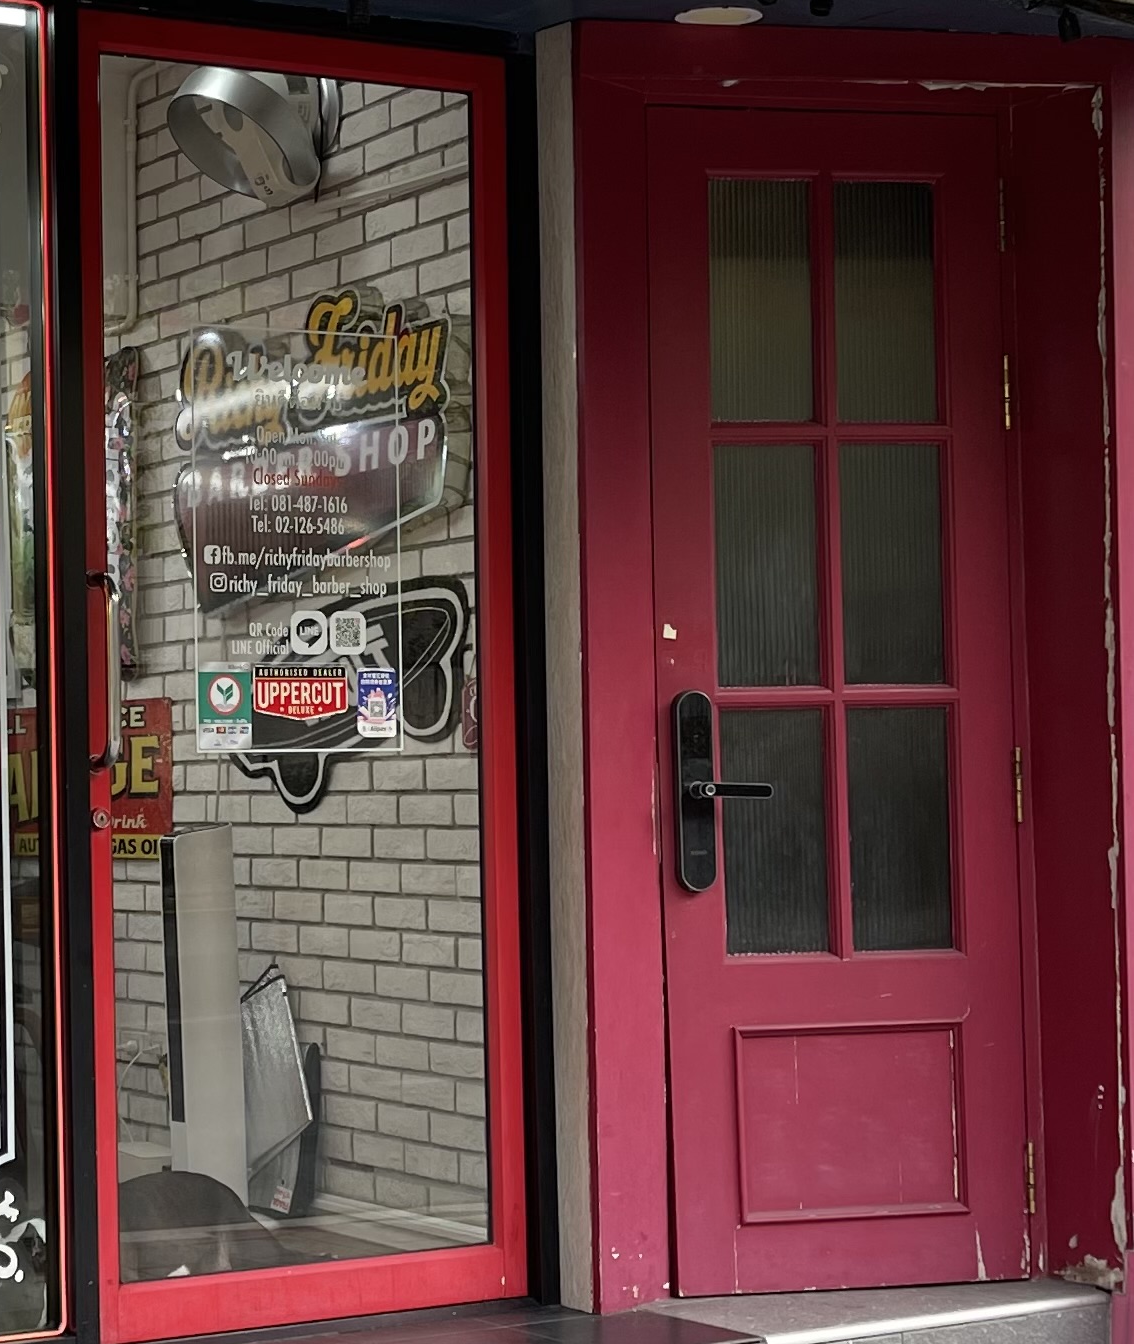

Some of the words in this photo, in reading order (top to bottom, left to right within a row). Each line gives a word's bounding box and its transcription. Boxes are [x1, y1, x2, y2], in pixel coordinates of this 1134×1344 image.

[226, 351, 365, 385] Welcome
[257, 426, 285, 445] Open
[253, 468, 290, 486] Closed
[249, 495, 267, 512] Tel:
[271, 495, 348, 513] 081-487-1616
[251, 514, 271, 533] Tel:
[275, 516, 345, 535] 02-126-5486
[222, 546, 391, 571] fb.me/richyfridaybarbershop
[229, 574, 387, 597] richy_friday_barber_shop
[249, 623, 263, 637] QR
[266, 622, 289, 637] Code
[232, 640, 253, 654] LINE
[256, 639, 290, 655] Official
[258, 668, 308, 677] AUTHORISED
[313, 668, 343, 676] DEALER
[257, 681, 344, 709] UPPERCUT
[288, 706, 314, 715] DELUXE
[112, 808, 147, 829] rink
